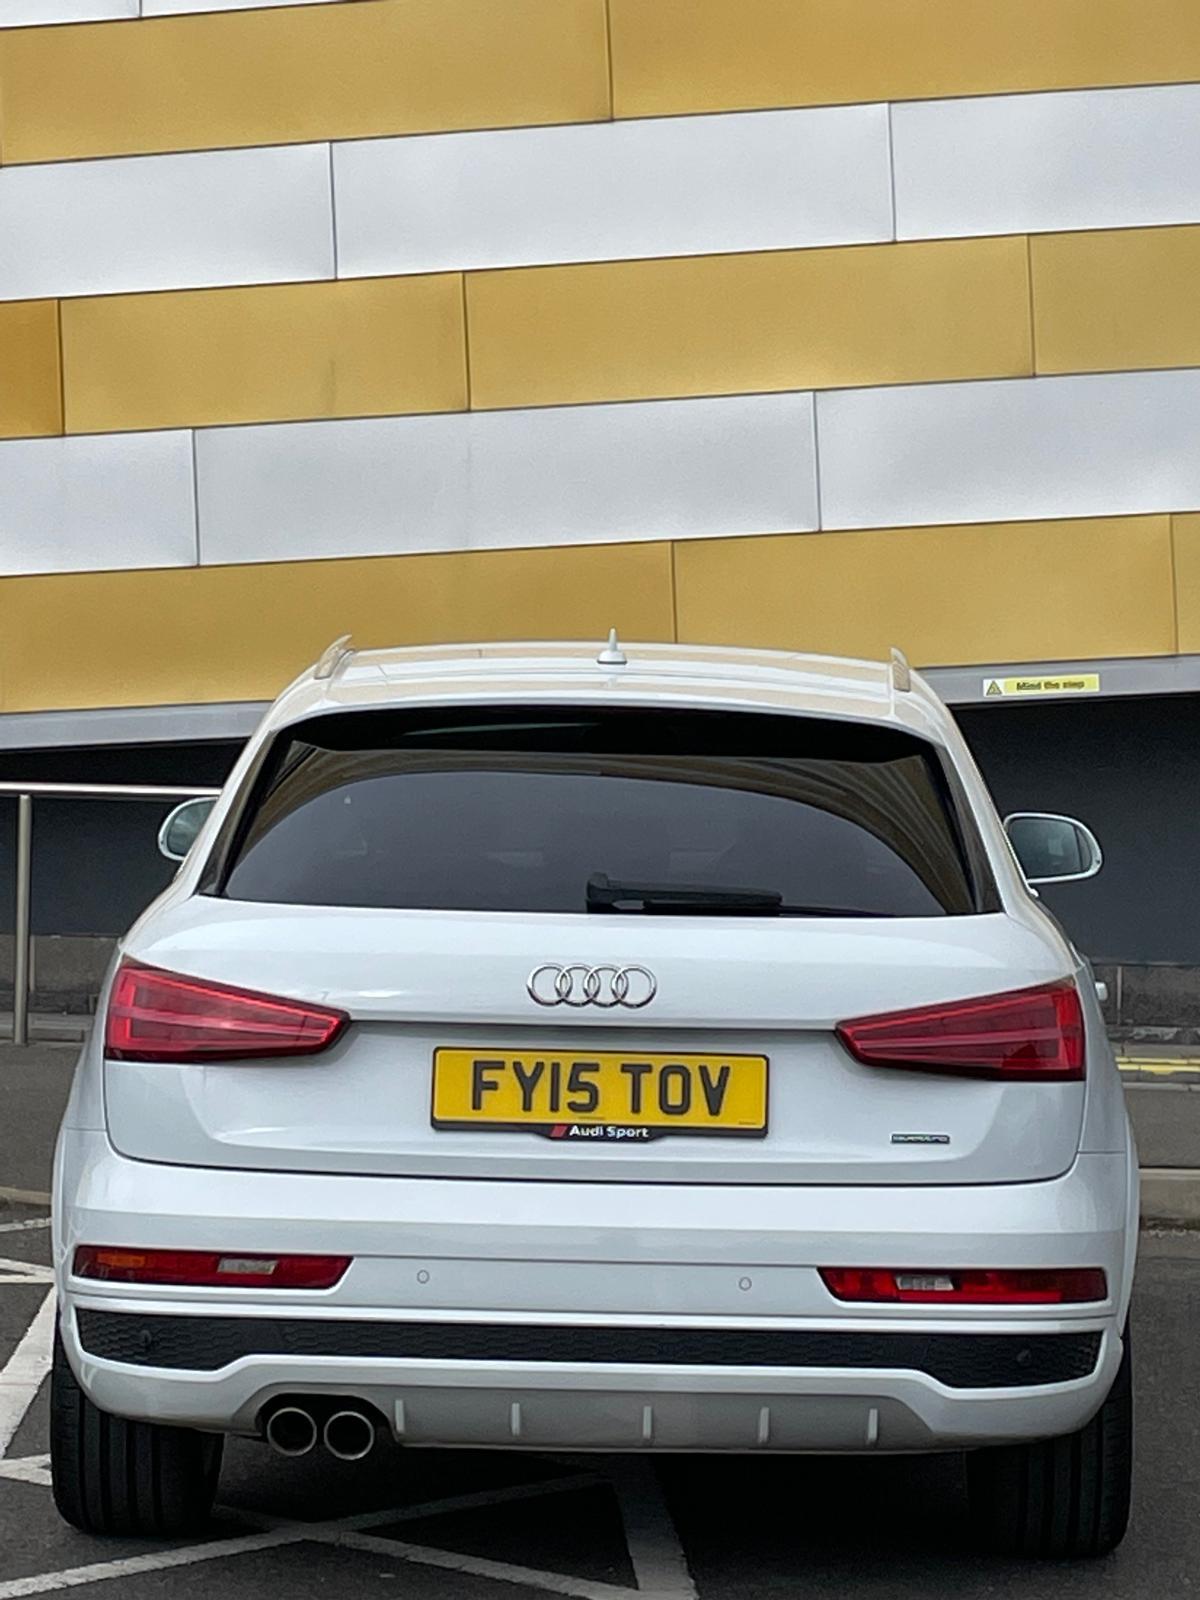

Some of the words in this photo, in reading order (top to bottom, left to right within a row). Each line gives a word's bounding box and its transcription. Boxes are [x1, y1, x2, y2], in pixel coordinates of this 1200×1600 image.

[472, 1060, 600, 1113] FY15
[621, 1063, 731, 1116] TOV
[569, 1125, 604, 1137] Audi
[606, 1126, 649, 1140] Sport
